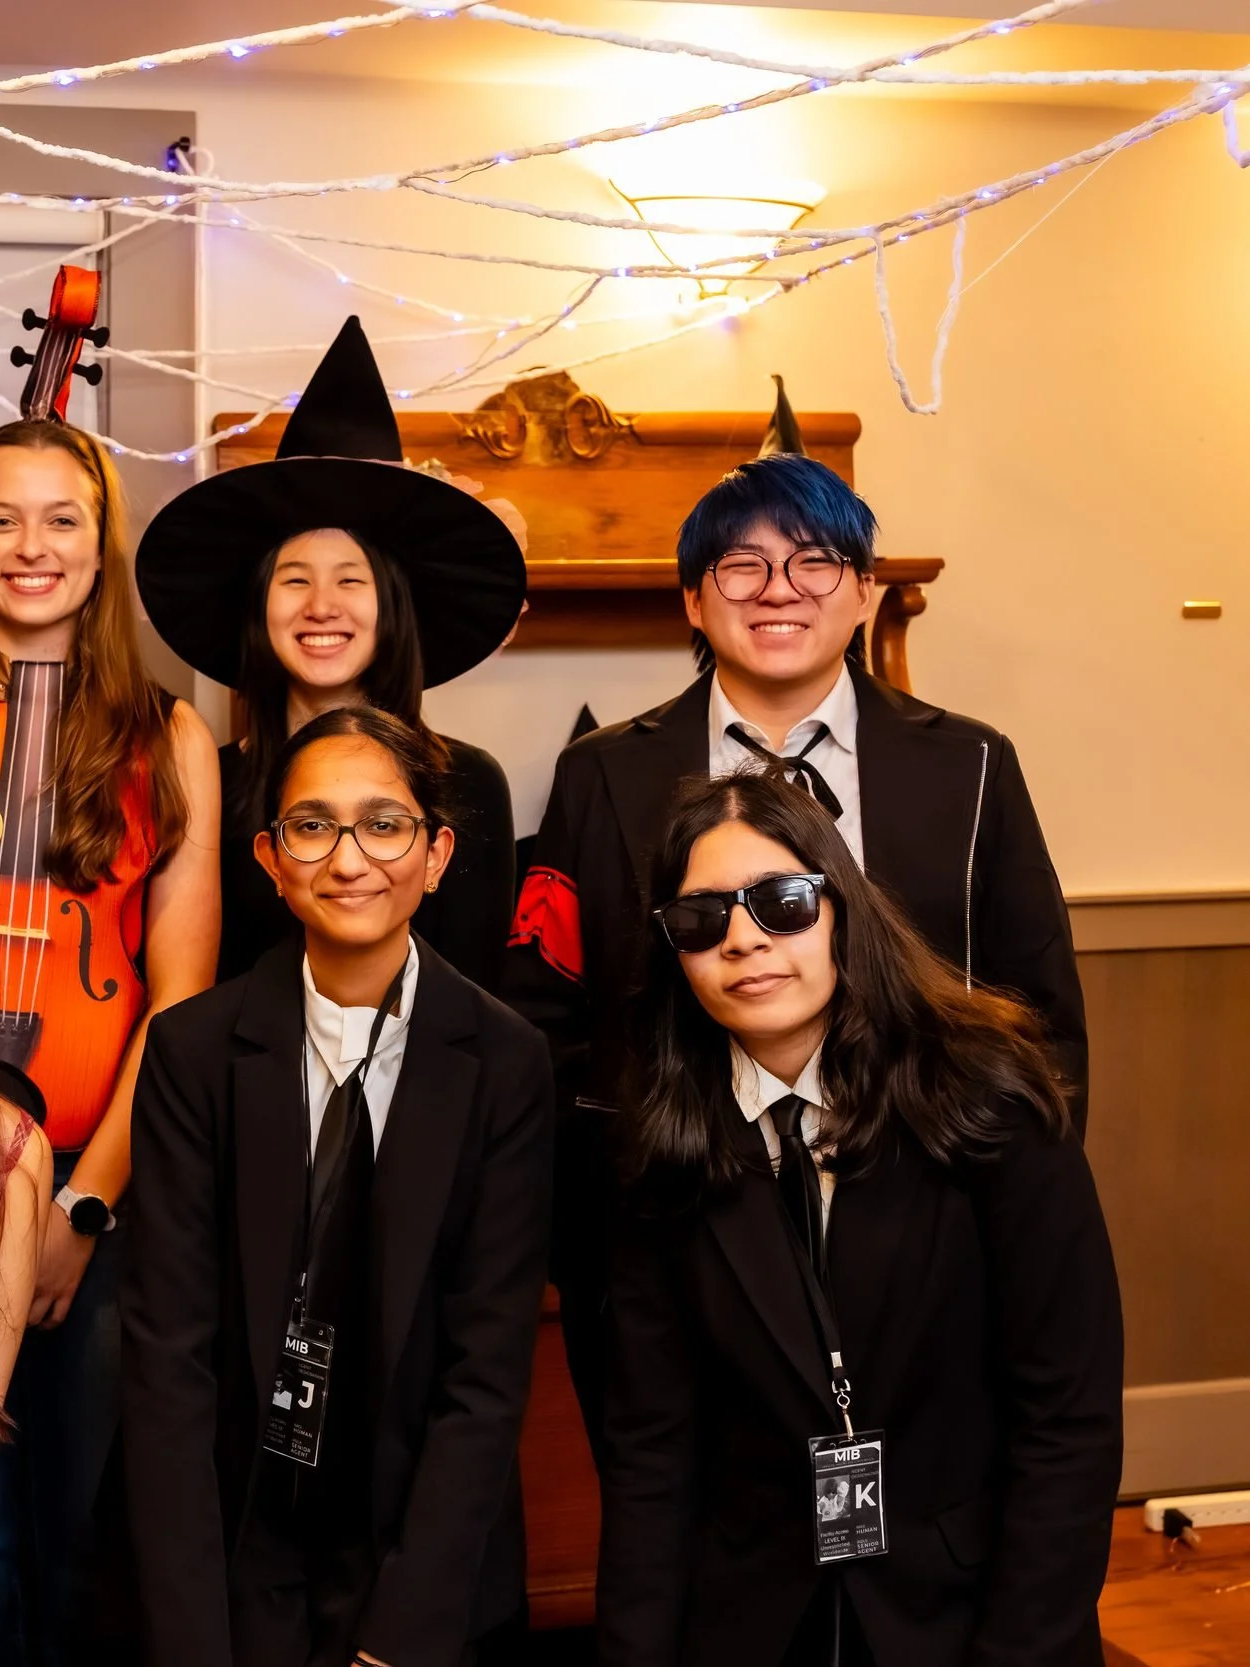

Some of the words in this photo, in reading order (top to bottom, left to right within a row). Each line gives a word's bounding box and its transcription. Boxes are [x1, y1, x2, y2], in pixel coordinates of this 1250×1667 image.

[285, 1336, 309, 1355] MIB
[297, 1380, 315, 1409] J
[290, 1448, 308, 1458] AGENT
[834, 1448, 861, 1463] MIB
[855, 1481, 877, 1509] K
[856, 1526, 878, 1534] HUMAN
[824, 1536, 840, 1544] LEVEL
[857, 1540, 879, 1550] SENIOR
[857, 1546, 877, 1554] AGENT
